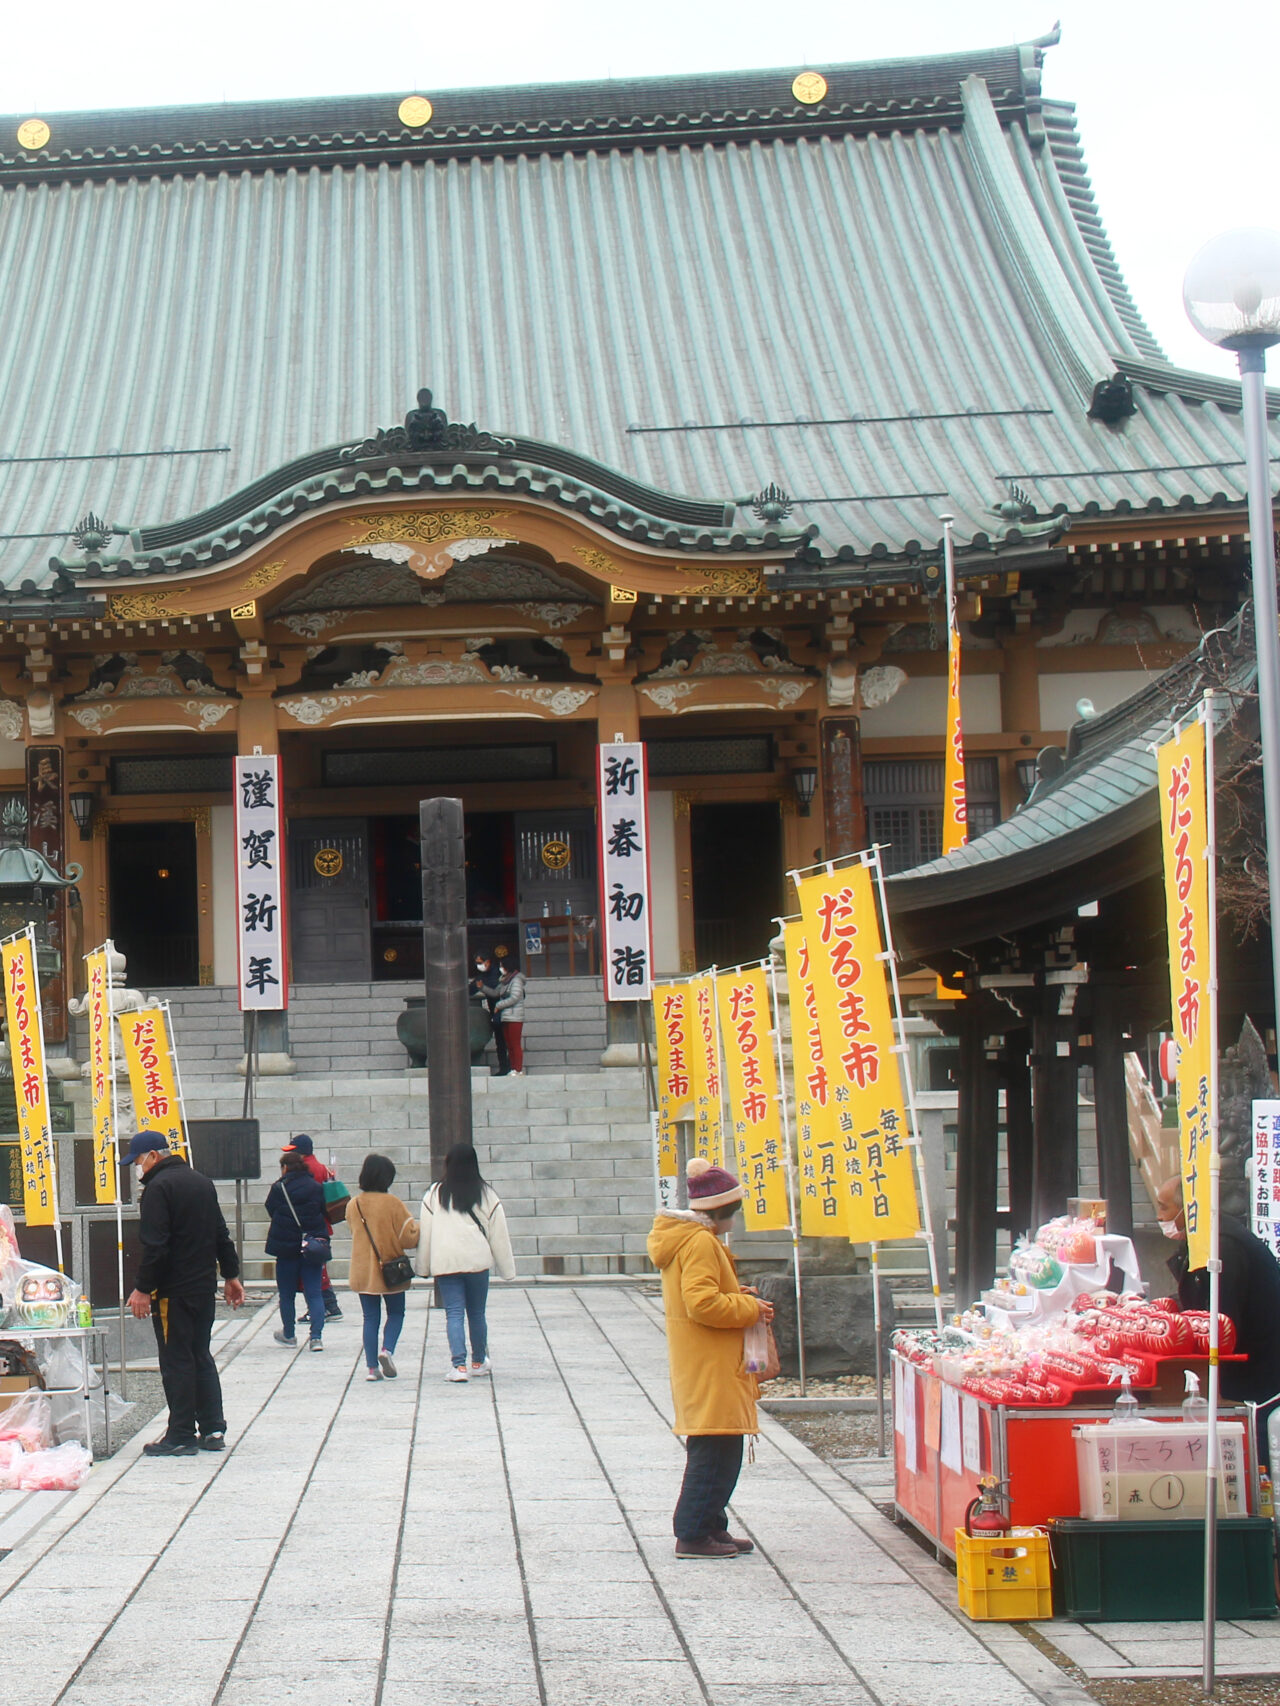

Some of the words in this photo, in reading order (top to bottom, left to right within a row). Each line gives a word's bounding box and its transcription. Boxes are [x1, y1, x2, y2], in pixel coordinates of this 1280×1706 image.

[241, 770, 279, 994] 謹賀新年
[604, 757, 646, 985] 新春初詣
[1169, 757, 1199, 1045] だるま市
[10, 956, 40, 1107] だるま市
[91, 967, 104, 1099] だるま市
[697, 988, 719, 1098] だるま市
[818, 889, 878, 1088] だるま市
[132, 1019, 169, 1118] だるま市
[664, 994, 688, 1098] だるま市
[729, 984, 766, 1124] だるま市
[34, 1140, 47, 1206] 一月十日
[751, 1152, 766, 1214] 一月十日
[765, 1139, 779, 1172] 毎年
[817, 1139, 836, 1217] 一月十日
[860, 1129, 889, 1218] 一月十日
[879, 1109, 903, 1156] 毎年
[1187, 1105, 1198, 1233] 一月十日
